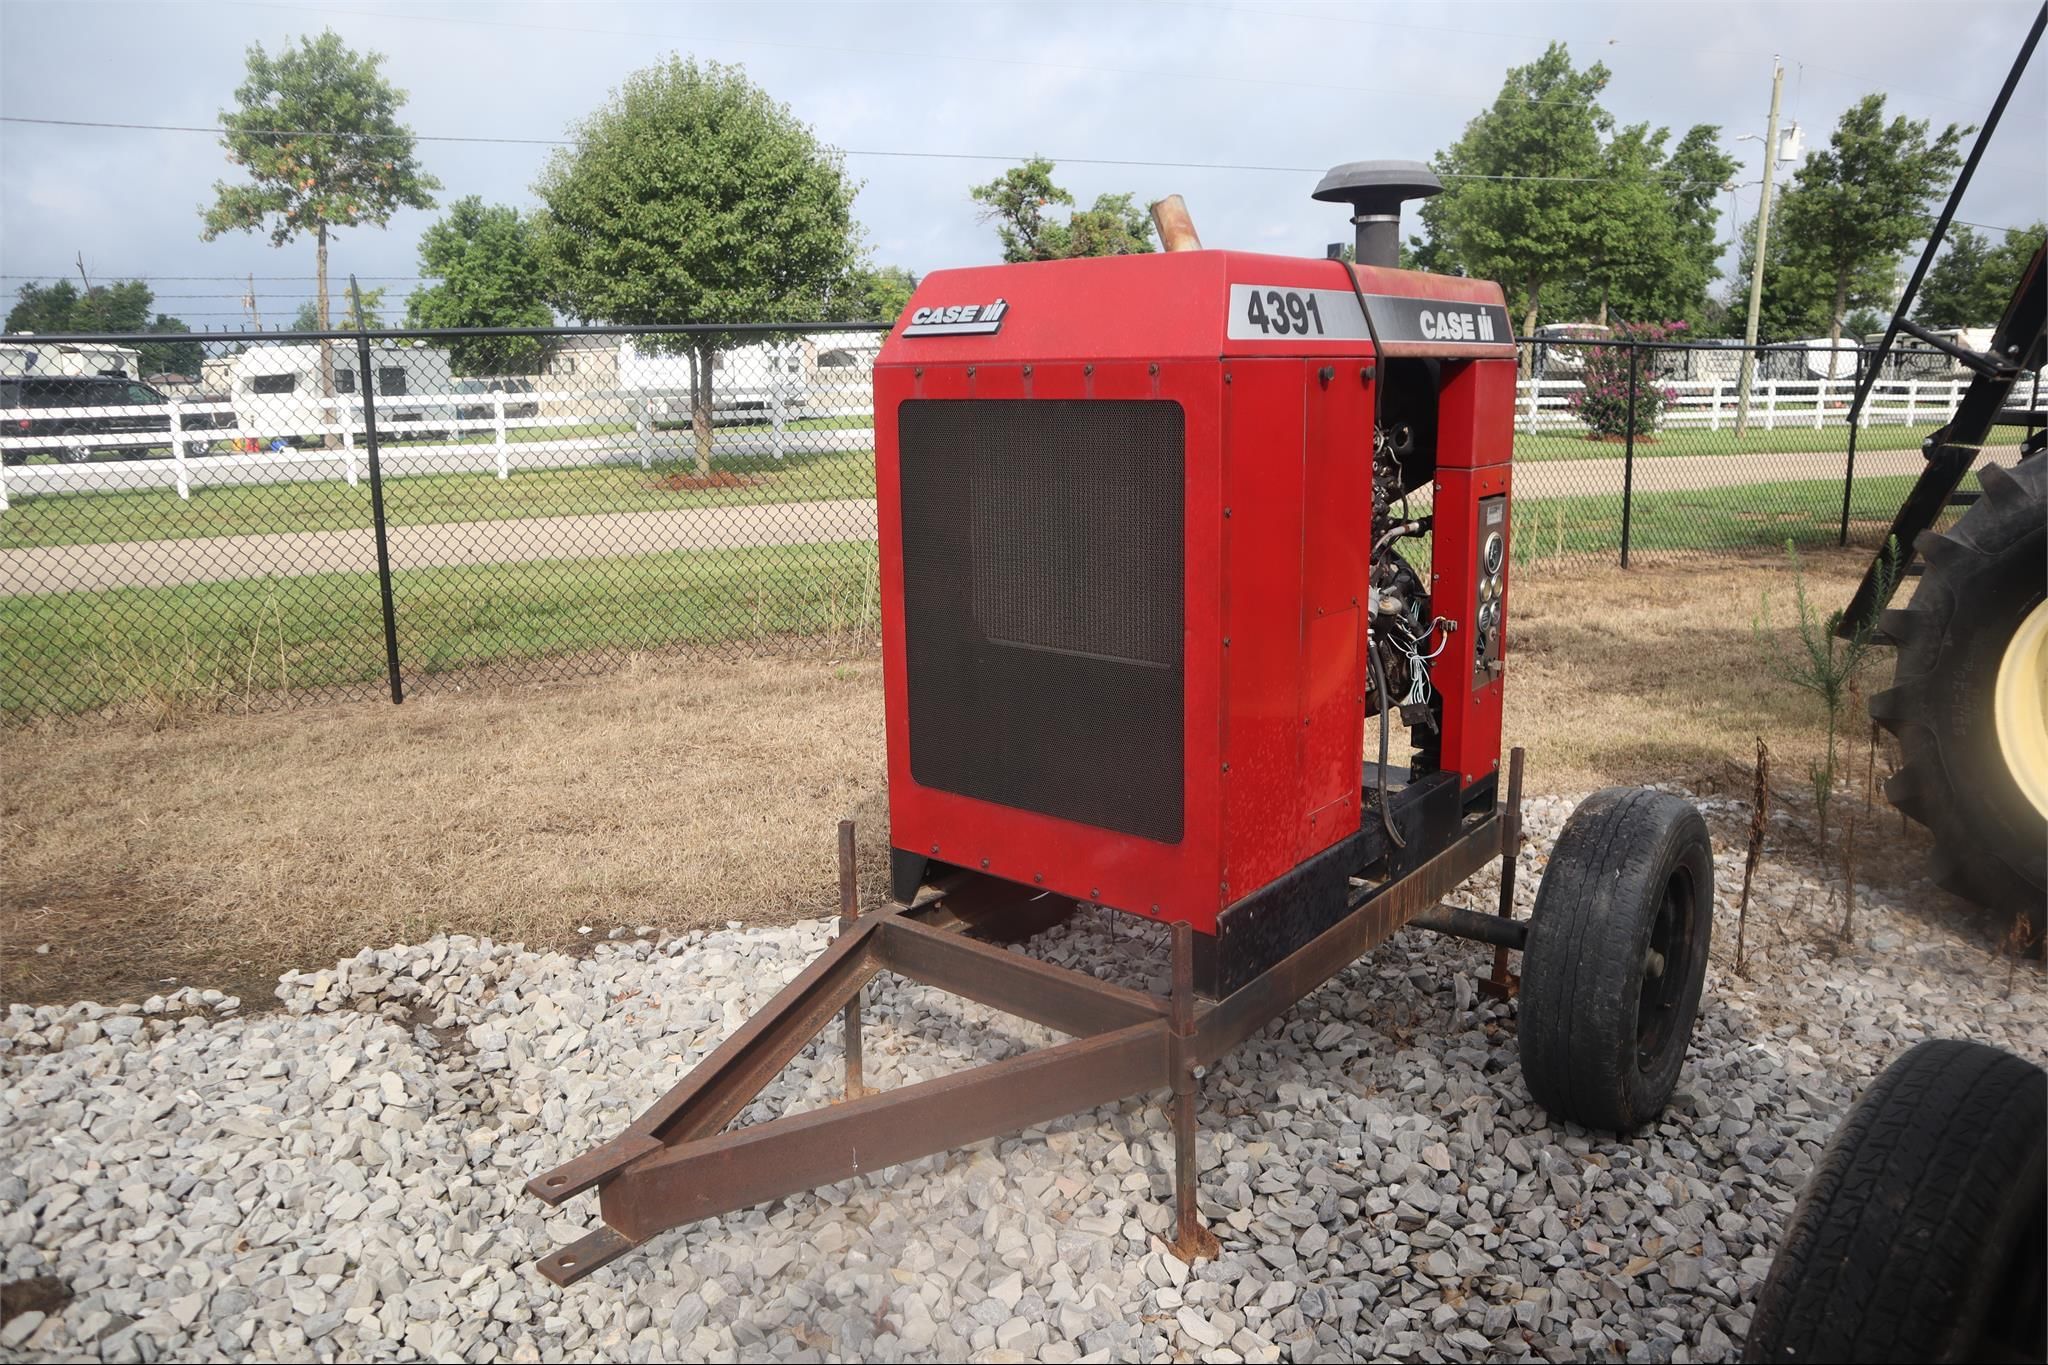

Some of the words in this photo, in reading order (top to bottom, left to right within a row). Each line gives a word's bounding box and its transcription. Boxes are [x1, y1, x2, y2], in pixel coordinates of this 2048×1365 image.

[911, 305, 980, 325] CASE
[1247, 289, 1324, 335] 4391
[1419, 309, 1476, 341] CASE
